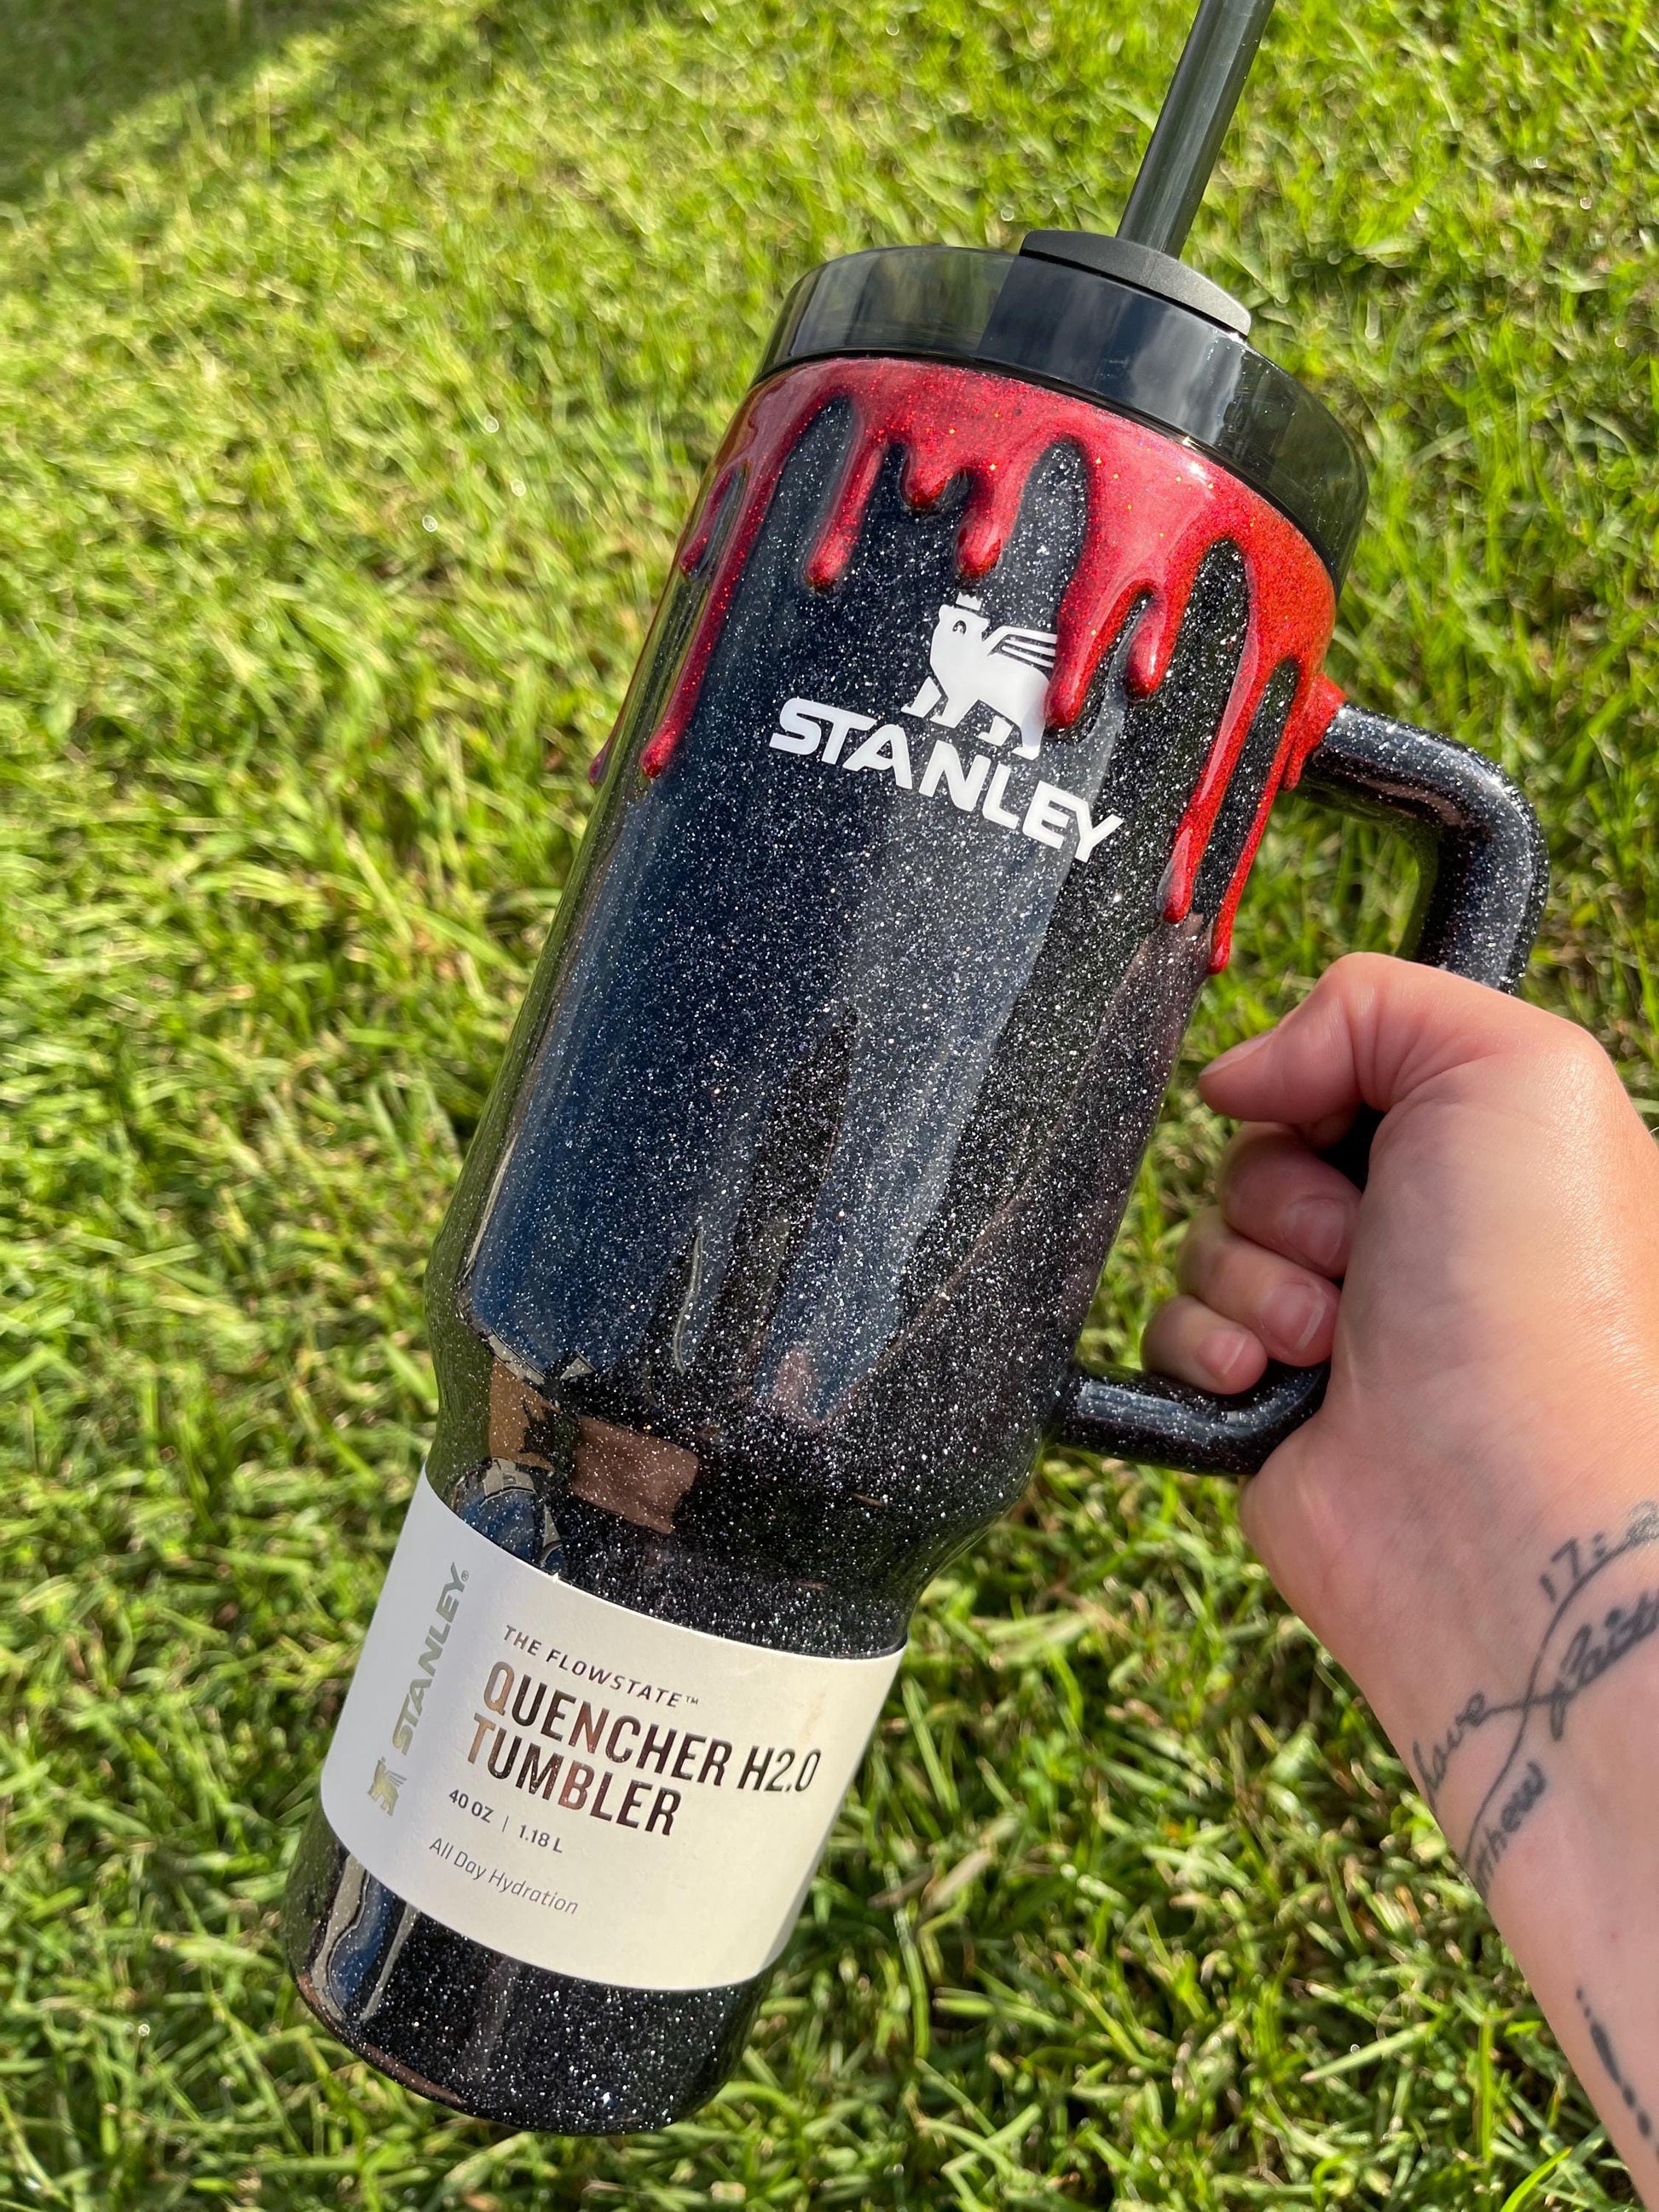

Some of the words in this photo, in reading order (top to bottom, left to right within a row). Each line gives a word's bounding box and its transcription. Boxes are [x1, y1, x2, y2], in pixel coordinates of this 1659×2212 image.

[769, 697, 1123, 863] STANLEY
[503, 1625, 542, 1656] THE
[467, 1712, 682, 1836] TUMBLER
[483, 1660, 733, 1787] QUENCHER
[737, 1746, 822, 1793] H2.0
[448, 1789, 469, 1809] 40
[471, 1801, 494, 1823] OZ
[519, 1824, 551, 1847] 1.18
[552, 1837, 564, 1854] L
[429, 1838, 454, 1860] All
[454, 1851, 487, 1880] Day
[488, 1869, 578, 1915] Hydration
